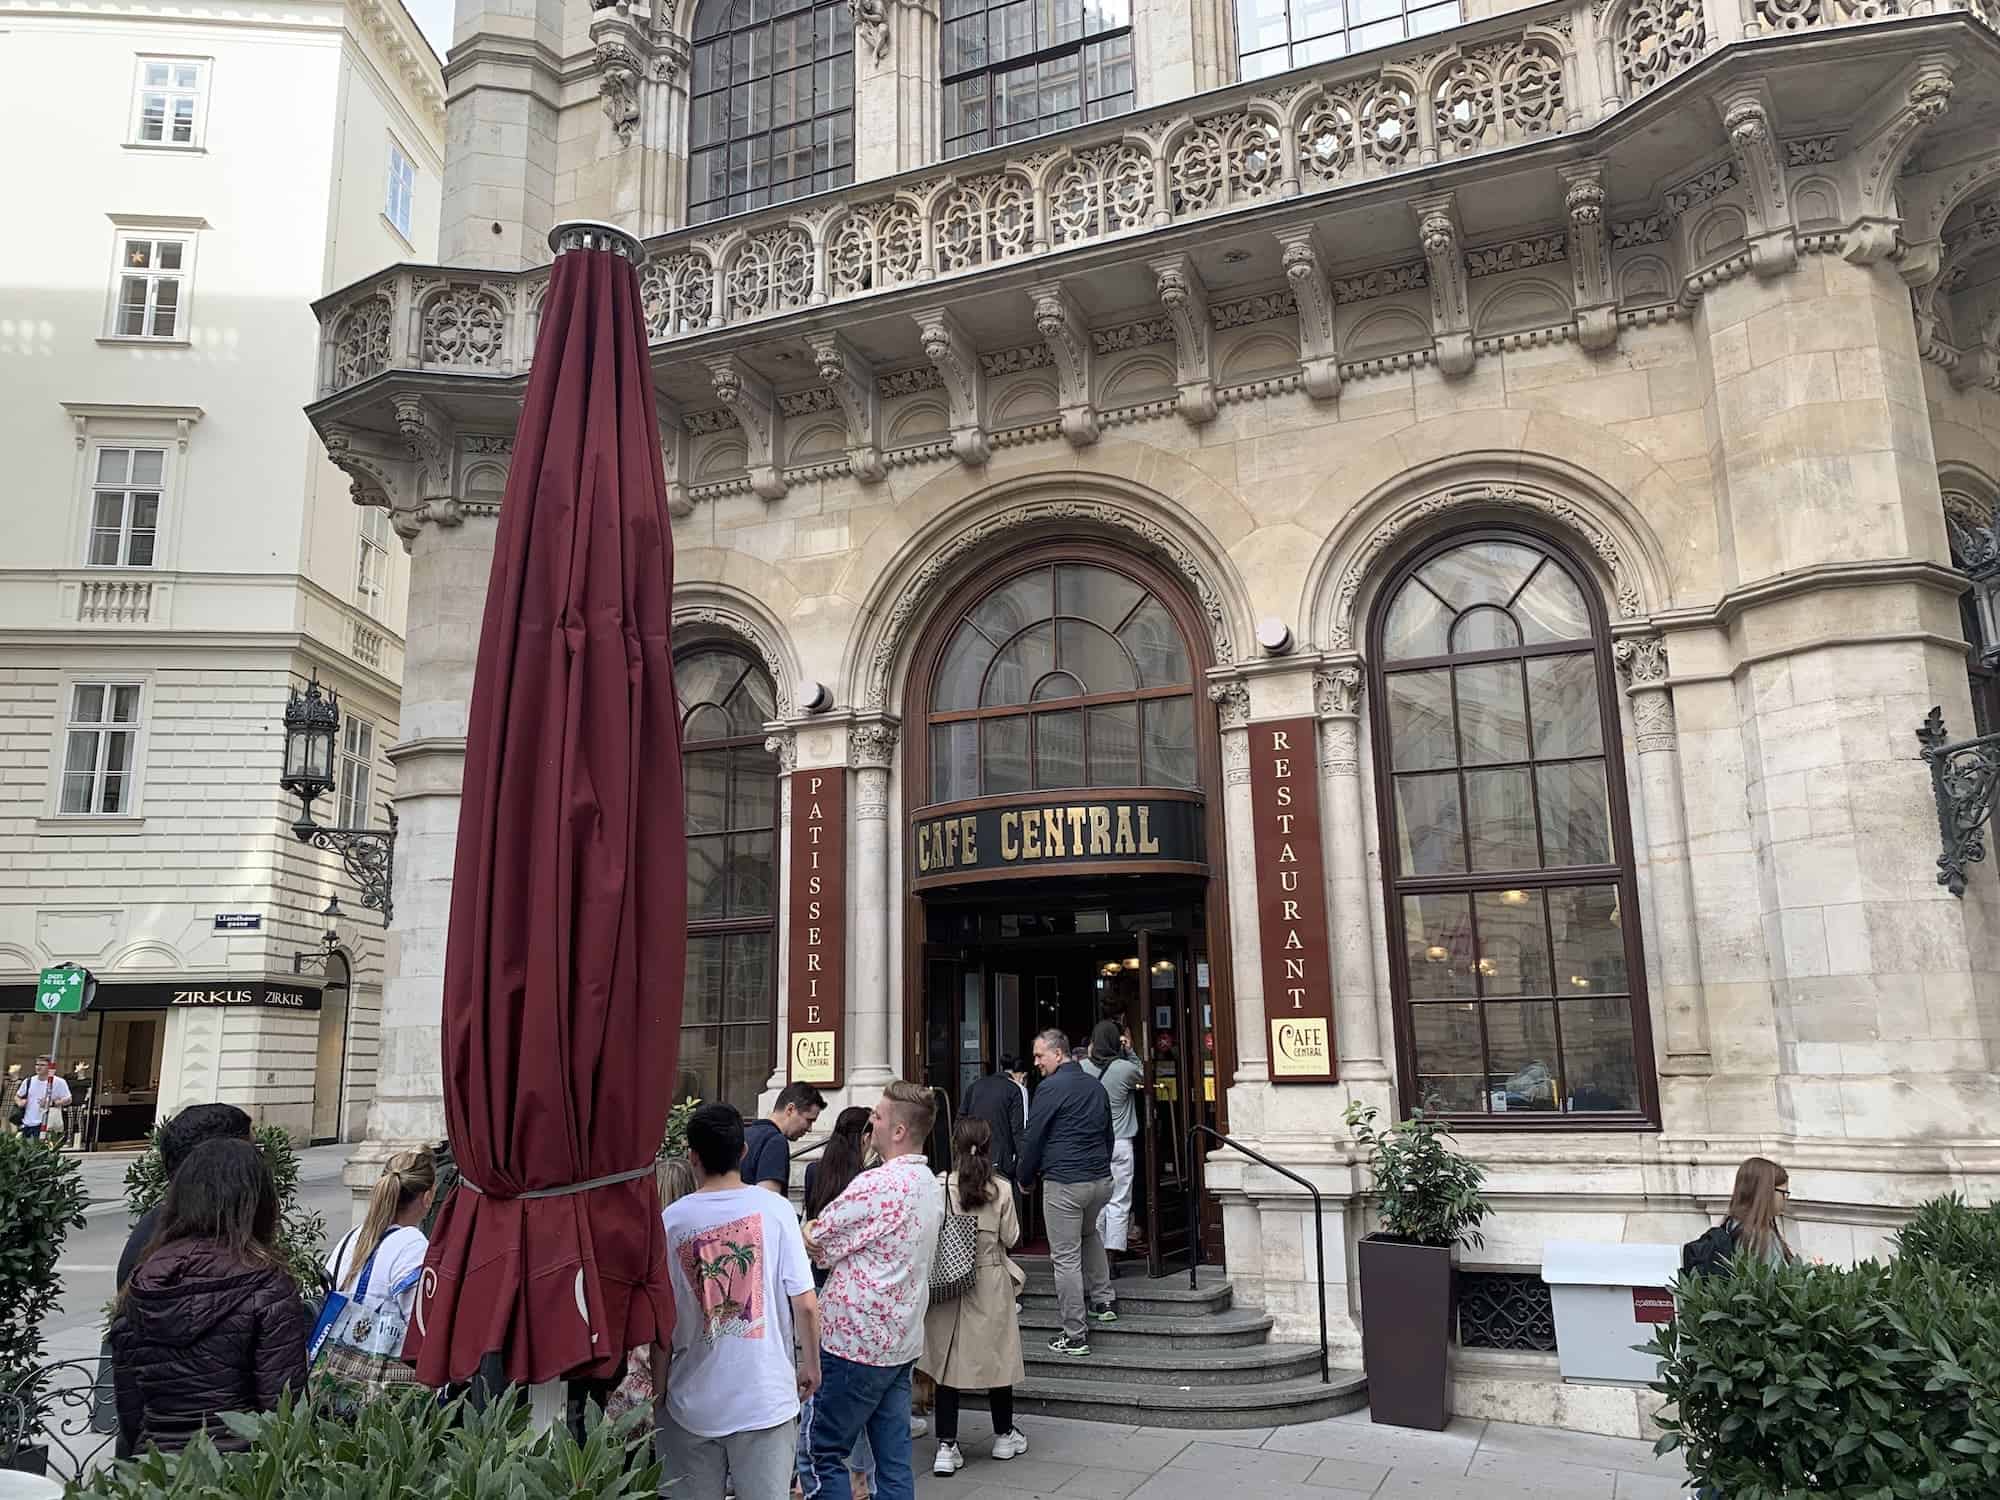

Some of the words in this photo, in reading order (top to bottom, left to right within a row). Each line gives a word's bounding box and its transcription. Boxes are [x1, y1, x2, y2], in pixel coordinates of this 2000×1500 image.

[919, 816, 977, 871] CAFE
[1001, 806, 1159, 860] CENTRAL
[1271, 731, 1306, 1009] RESTAURANT
[807, 777, 823, 1024] PATISSERIE
[172, 990, 252, 1003] ZIRKUS
[265, 991, 304, 1006] ZIRKUS
[796, 1037, 831, 1071] CAFE
[1279, 1024, 1322, 1061] CAFE
[1293, 1047, 1322, 1057] CENTRAL
